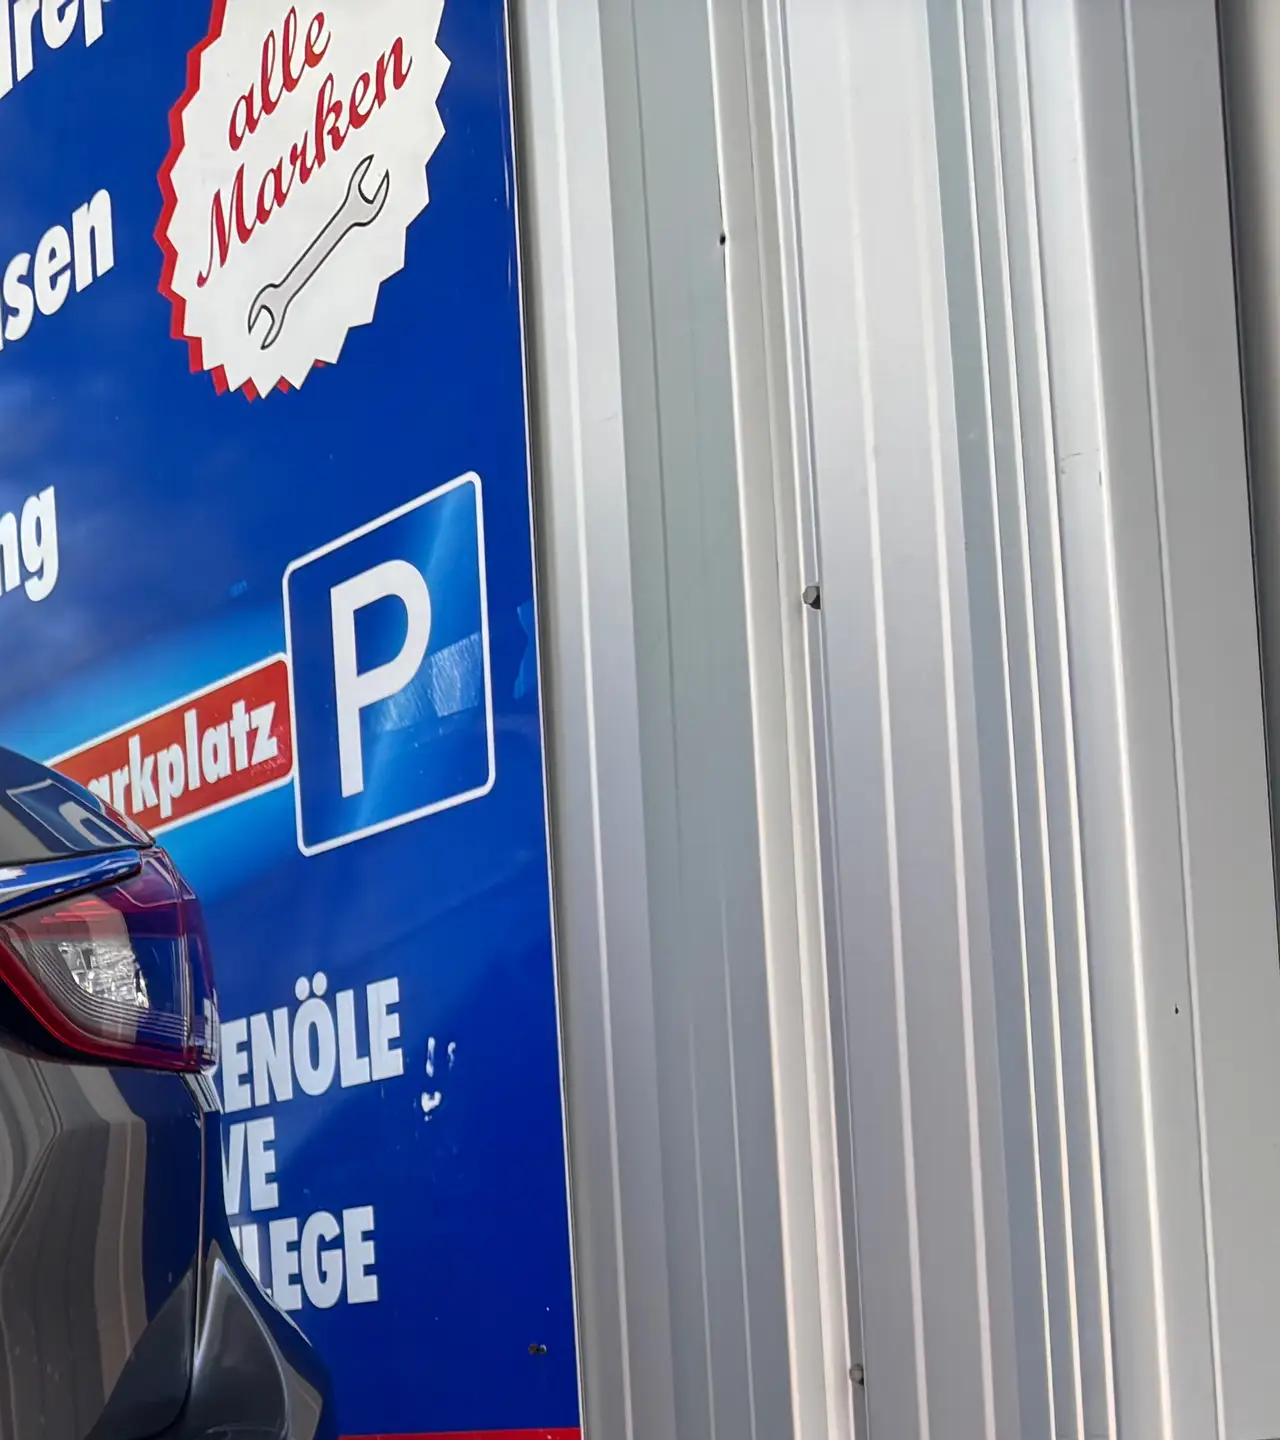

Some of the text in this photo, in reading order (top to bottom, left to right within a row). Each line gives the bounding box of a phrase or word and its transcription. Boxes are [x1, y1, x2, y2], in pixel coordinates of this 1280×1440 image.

[197, 37, 412, 288] Marken
[229, 6, 331, 151] alle
[331, 559, 431, 798] P
[229, 1205, 378, 1311] LEGE
